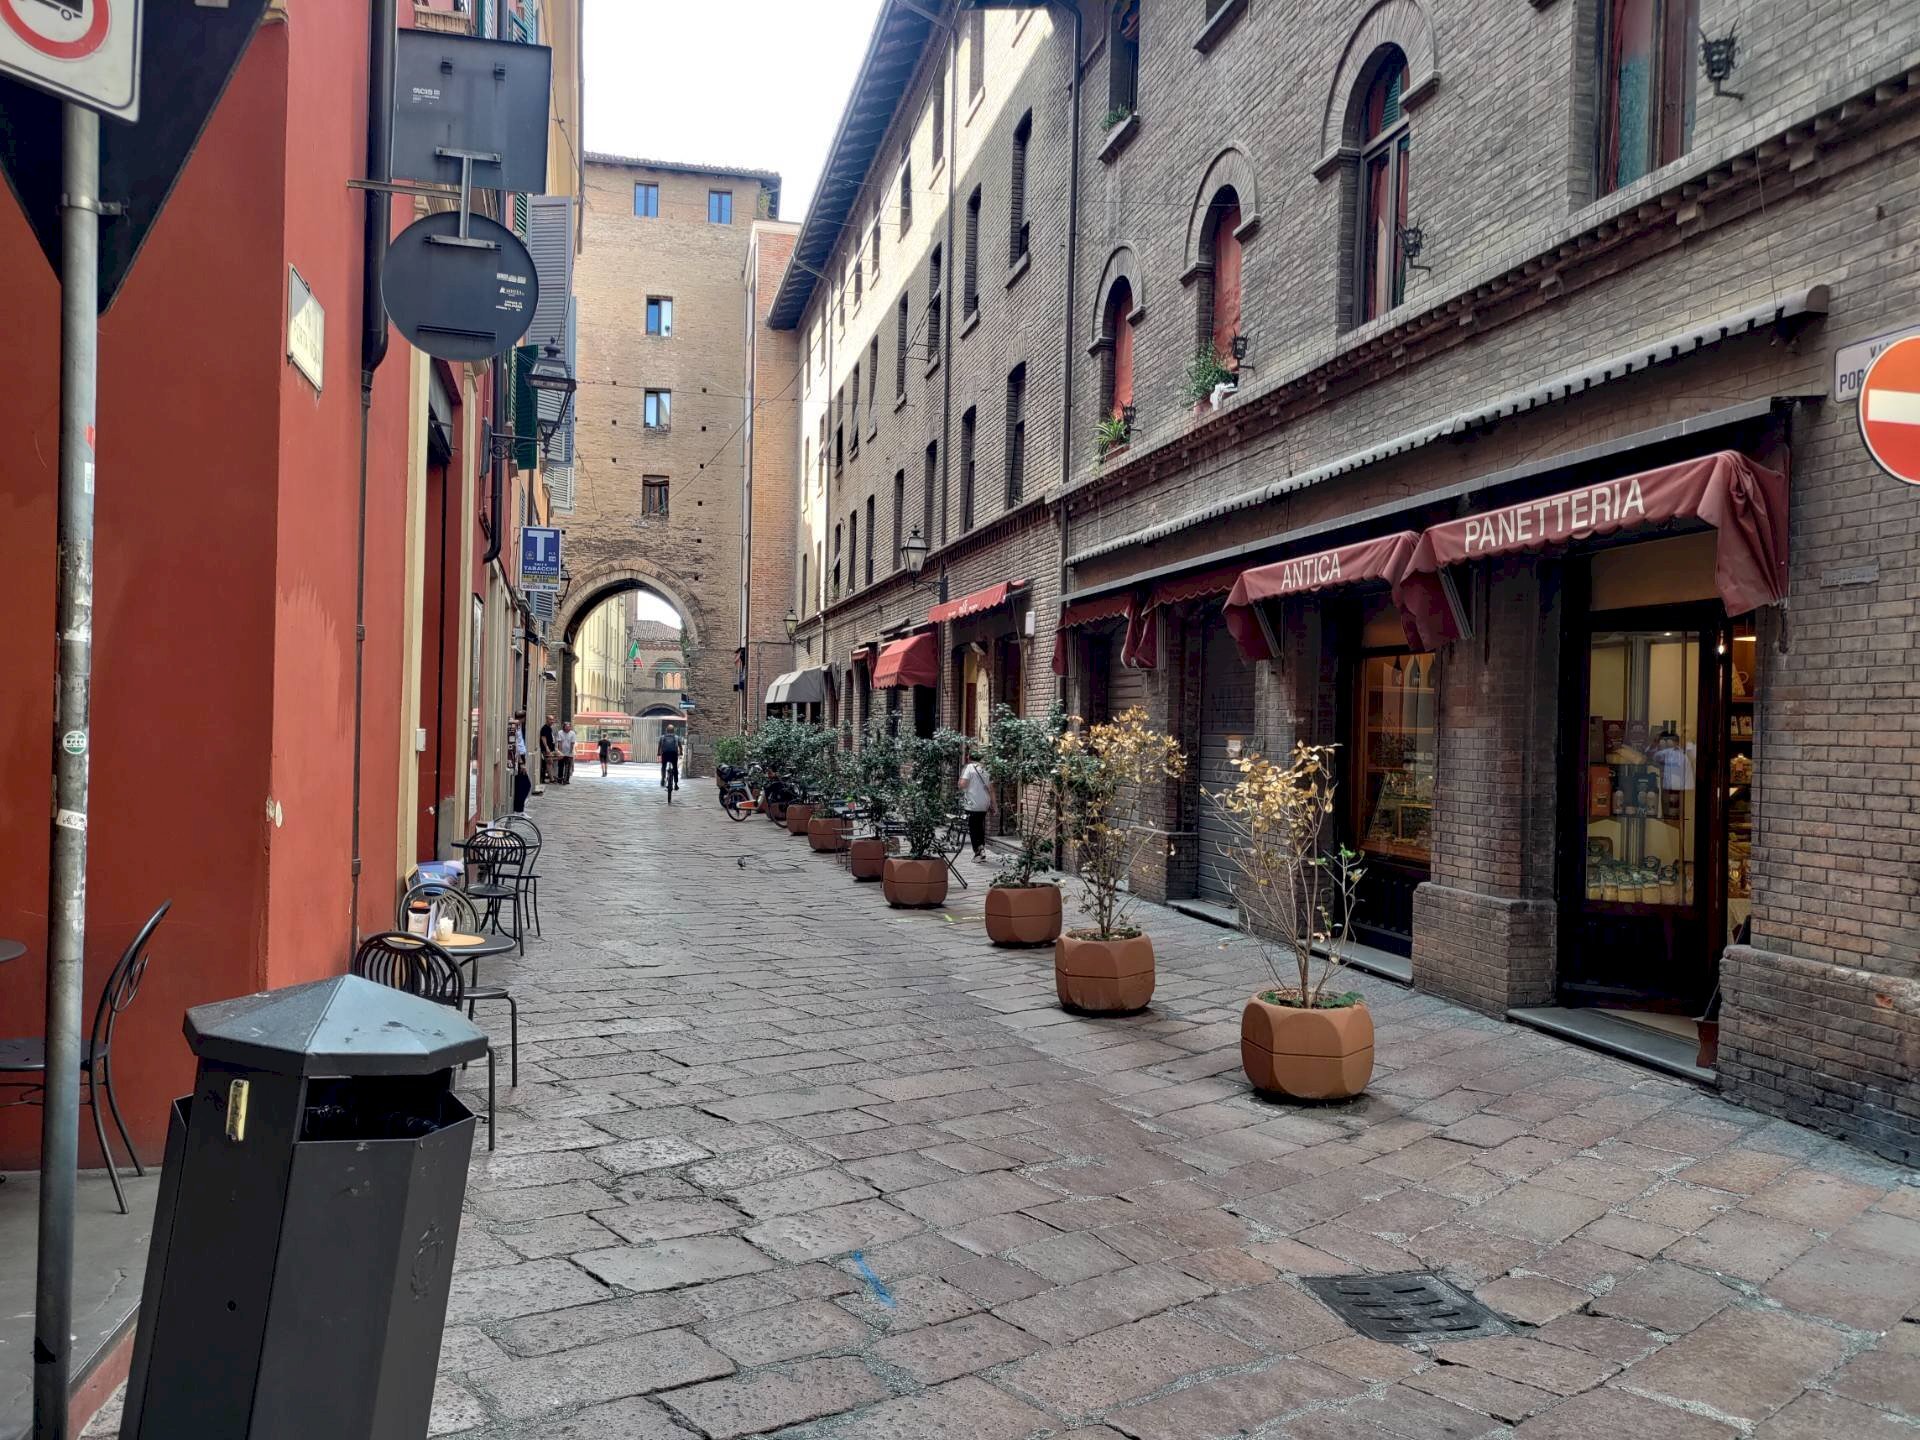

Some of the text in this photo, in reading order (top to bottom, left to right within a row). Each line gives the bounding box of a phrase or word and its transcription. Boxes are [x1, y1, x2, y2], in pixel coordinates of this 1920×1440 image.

[1464, 479, 1645, 553] PANETTERIA
[528, 530, 554, 561] T
[1281, 552, 1341, 590] ANTICA
